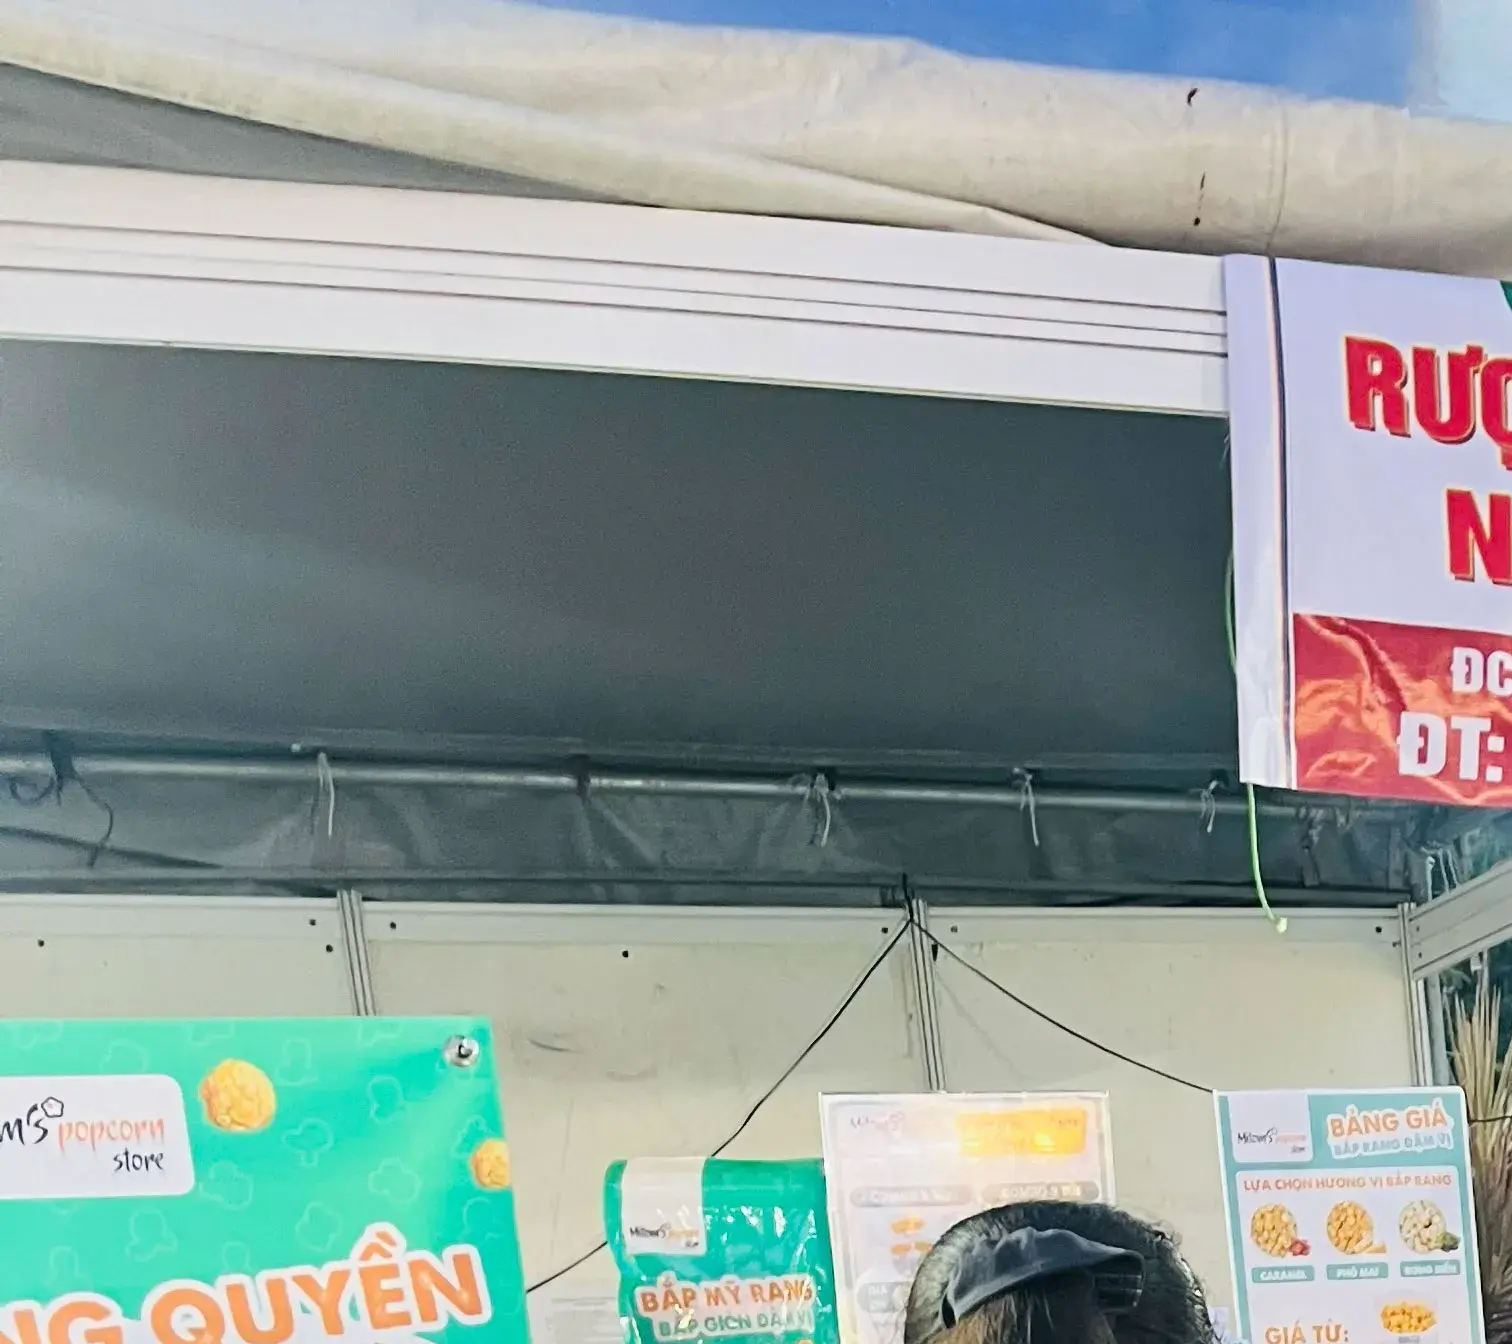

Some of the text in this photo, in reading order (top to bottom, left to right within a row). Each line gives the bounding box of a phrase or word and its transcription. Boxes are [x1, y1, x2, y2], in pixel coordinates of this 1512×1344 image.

[1398, 711, 1505, 783] ĐT:
[58, 1118, 165, 1152] popcorn
[1331, 1102, 1448, 1138] BẢNG GIÁ
[113, 1147, 164, 1172] store
[1244, 1178, 1271, 1193] LỰA
[1276, 1176, 1312, 1192] CHỌN
[641, 1276, 696, 1313] BẮP
[704, 1280, 740, 1306] MỸ
[1312, 1318, 1349, 1343] TỪ:
